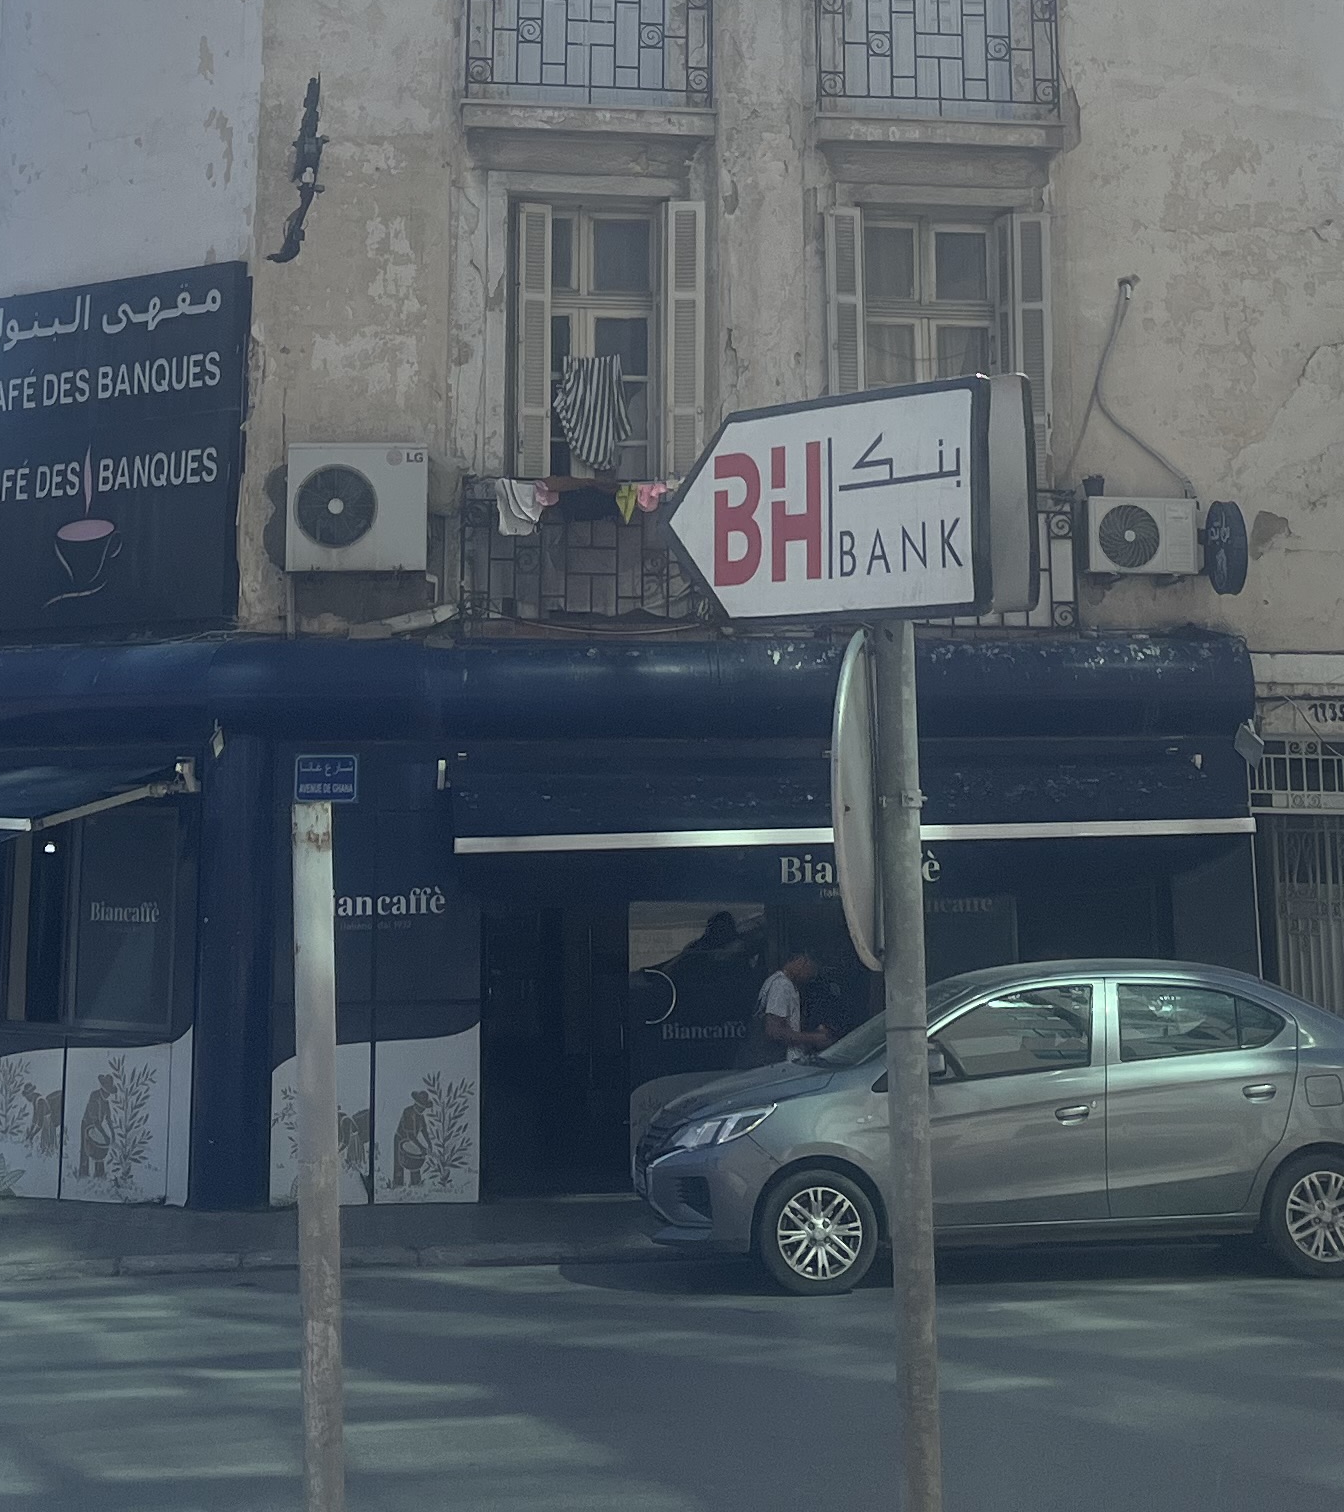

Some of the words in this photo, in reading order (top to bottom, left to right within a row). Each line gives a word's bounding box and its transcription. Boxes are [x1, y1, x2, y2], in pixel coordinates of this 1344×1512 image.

[102, 283, 222, 334] مقهى
[42, 368, 90, 407] DES
[97, 351, 221, 399] BANQUES
[35, 461, 80, 499] DES
[97, 447, 218, 492] BANQUES
[405, 451, 424, 464] LG
[838, 432, 961, 492] بنك
[714, 441, 822, 587] BH
[839, 517, 964, 578] BANK
[299, 783, 322, 794] AVENUE
[322, 783, 332, 794] DE
[90, 901, 160, 923] Biancaffè
[332, 885, 446, 917] ancaffè
[661, 1021, 747, 1040] Biancaffè
